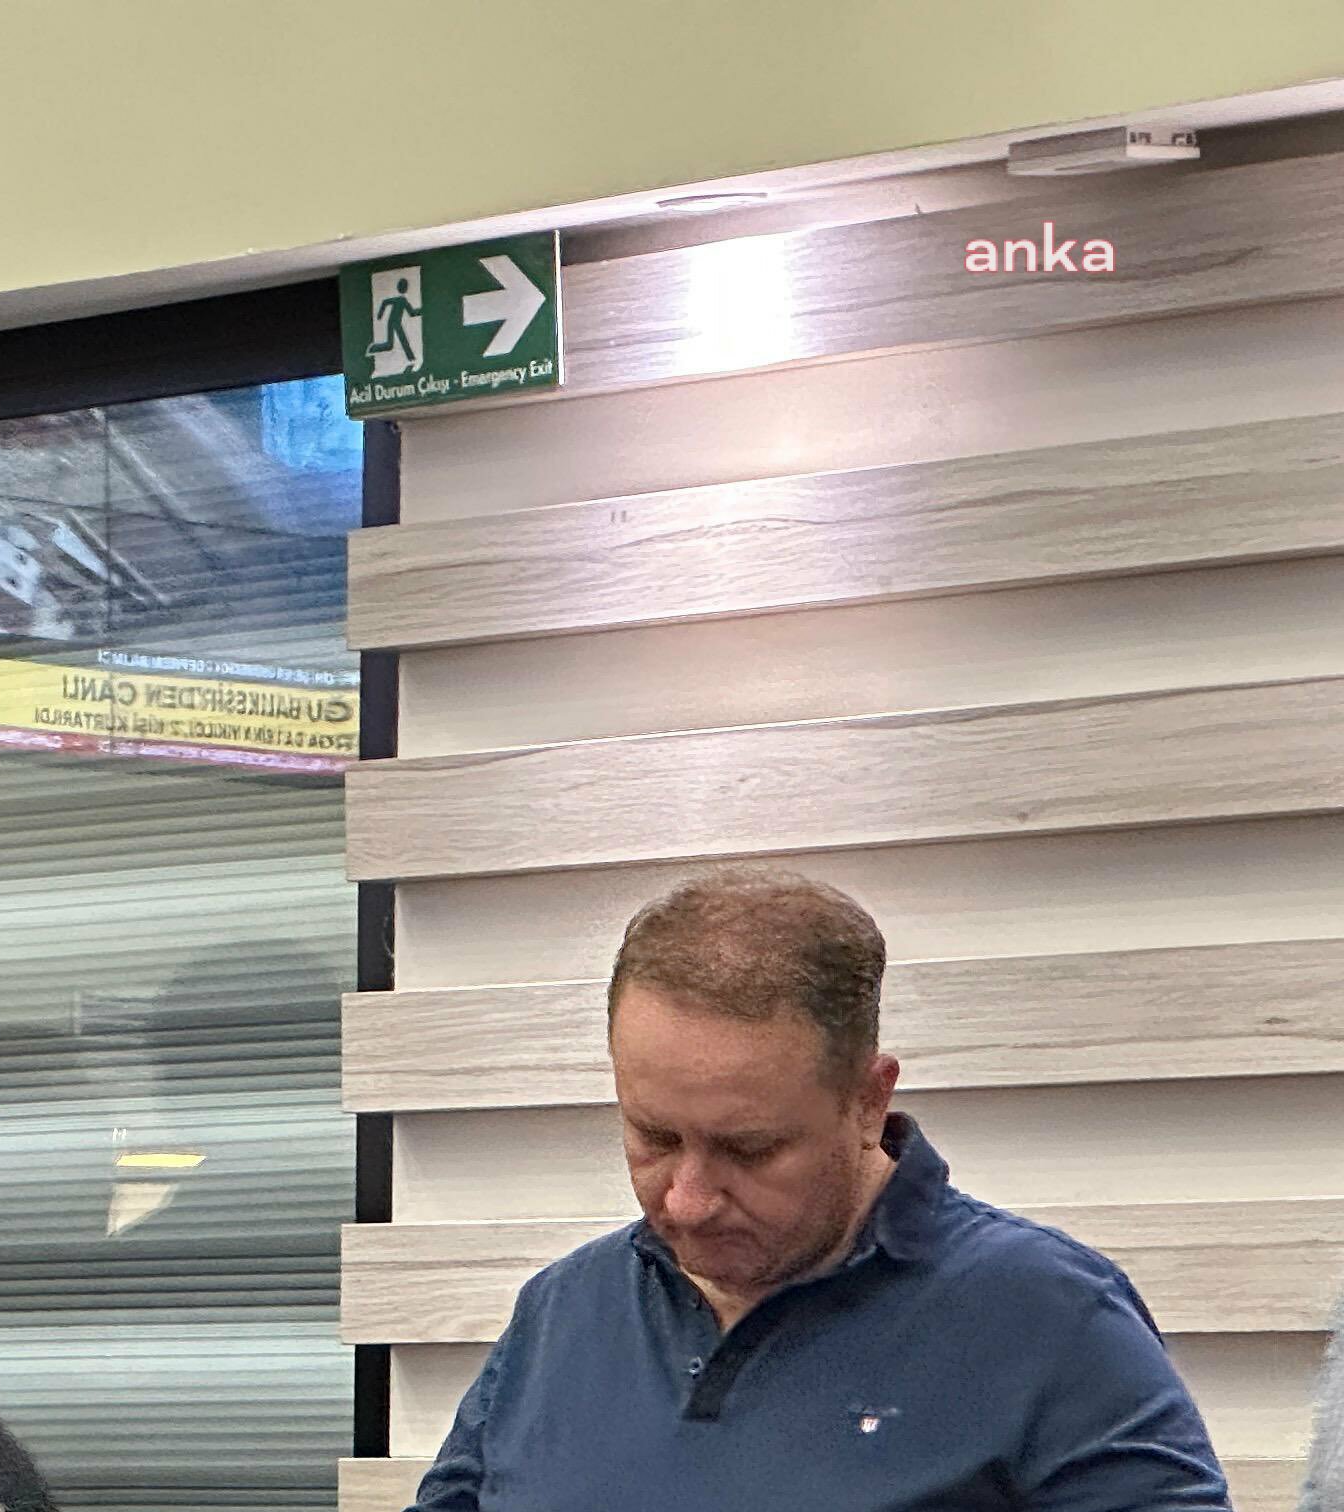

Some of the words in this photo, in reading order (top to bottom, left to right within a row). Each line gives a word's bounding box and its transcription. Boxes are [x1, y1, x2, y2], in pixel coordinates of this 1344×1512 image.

[374, 383, 416, 399] Durum
[462, 366, 527, 388] Emergency
[529, 359, 553, 377] Exit
